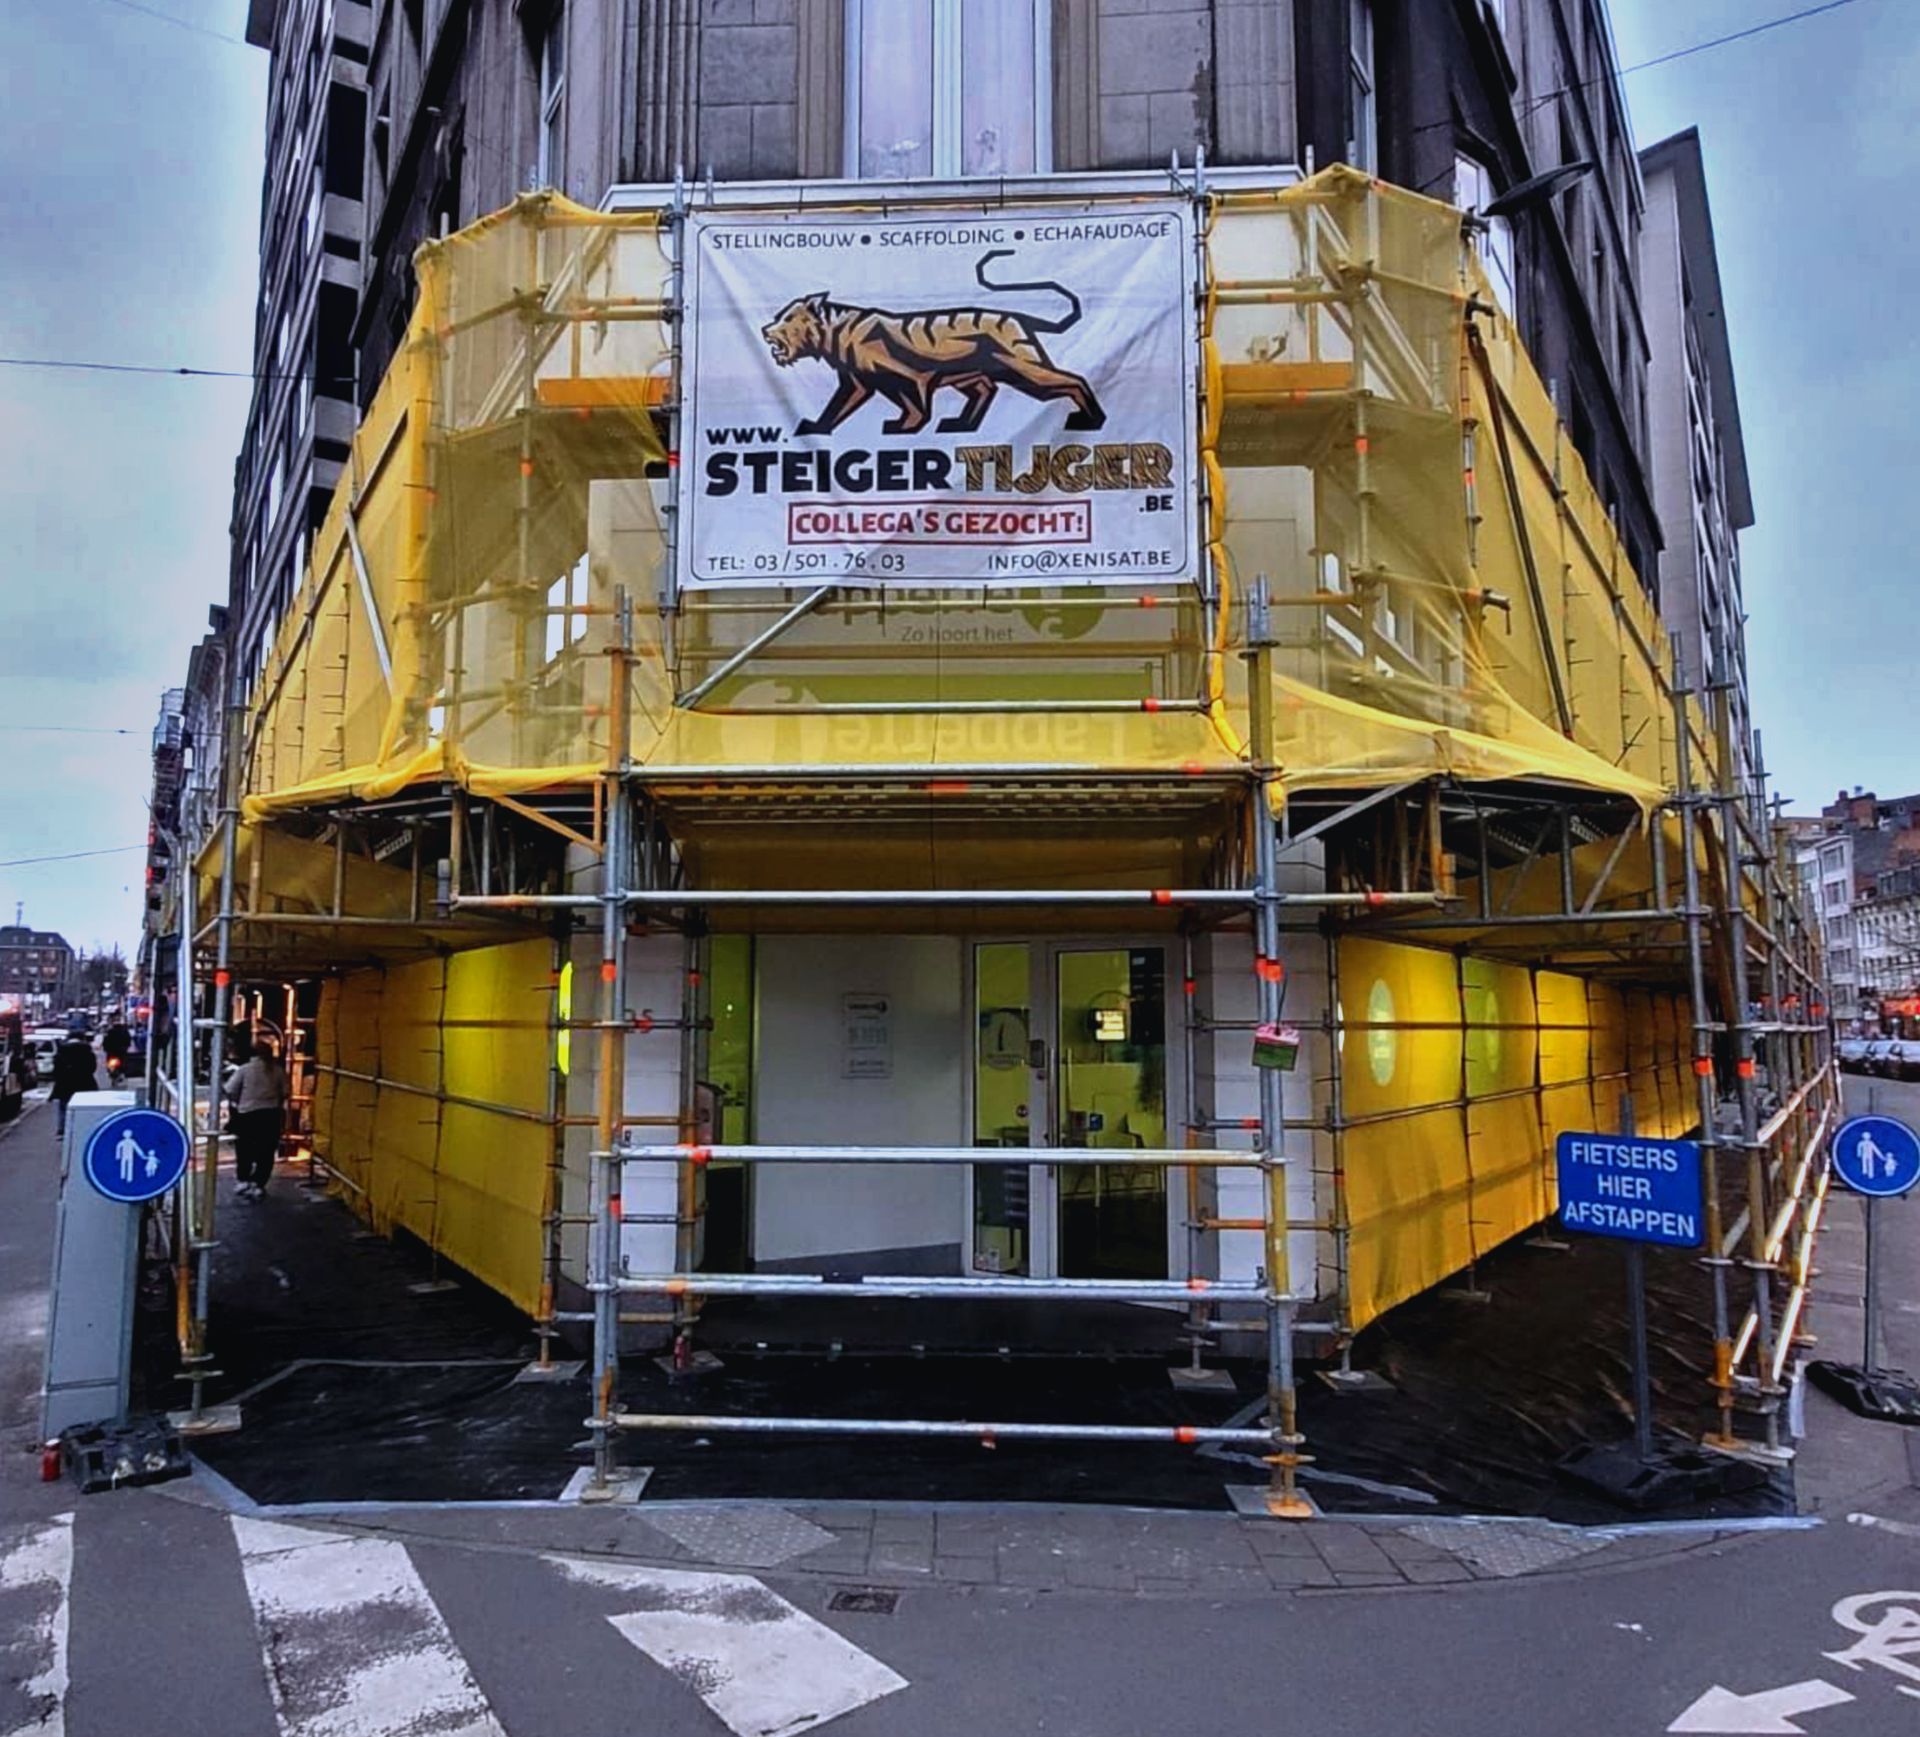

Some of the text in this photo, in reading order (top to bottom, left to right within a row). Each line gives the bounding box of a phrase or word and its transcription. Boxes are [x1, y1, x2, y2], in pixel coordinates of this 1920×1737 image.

[712, 221, 1171, 249] STELLINGBOUW SCAFFOLDING ECHAFAUDAGE
[1138, 494, 1174, 513] .BE
[795, 508, 1083, 535] COLLEGA'S GEZOCHT!
[708, 556, 746, 571] TEL:
[987, 550, 1172, 572] INFO@XENISAT.BE
[902, 625, 1014, 642] Zo hoort het
[1570, 1141, 1679, 1172] FIETSERS
[1597, 1173, 1652, 1200] HIER
[1564, 1200, 1696, 1239] AFSTAPPEN
